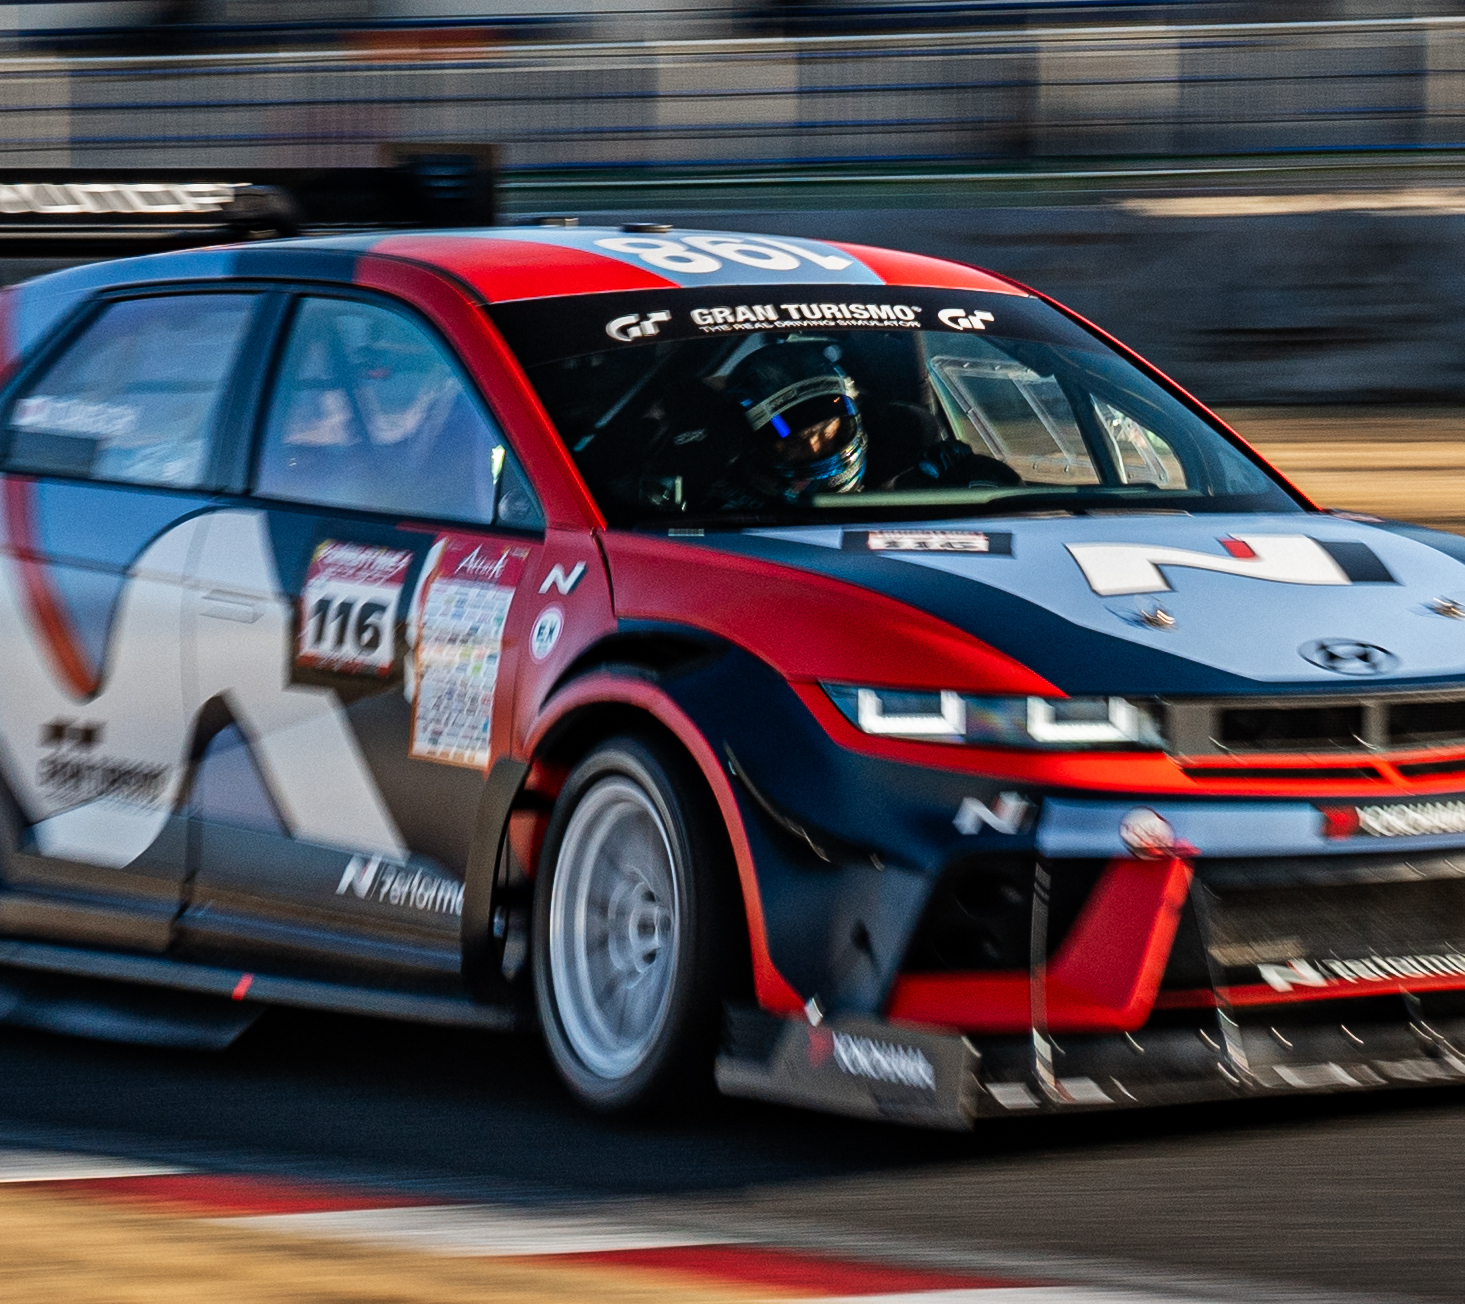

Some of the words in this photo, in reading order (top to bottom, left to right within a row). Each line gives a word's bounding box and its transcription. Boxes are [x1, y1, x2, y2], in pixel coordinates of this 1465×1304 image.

[690, 304, 780, 326] GRAN
[698, 324, 732, 334] THE
[733, 322, 773, 331] REAL
[774, 319, 835, 329] DRIVING
[835, 319, 922, 329] SIMULATOR
[309, 596, 389, 656] 116
